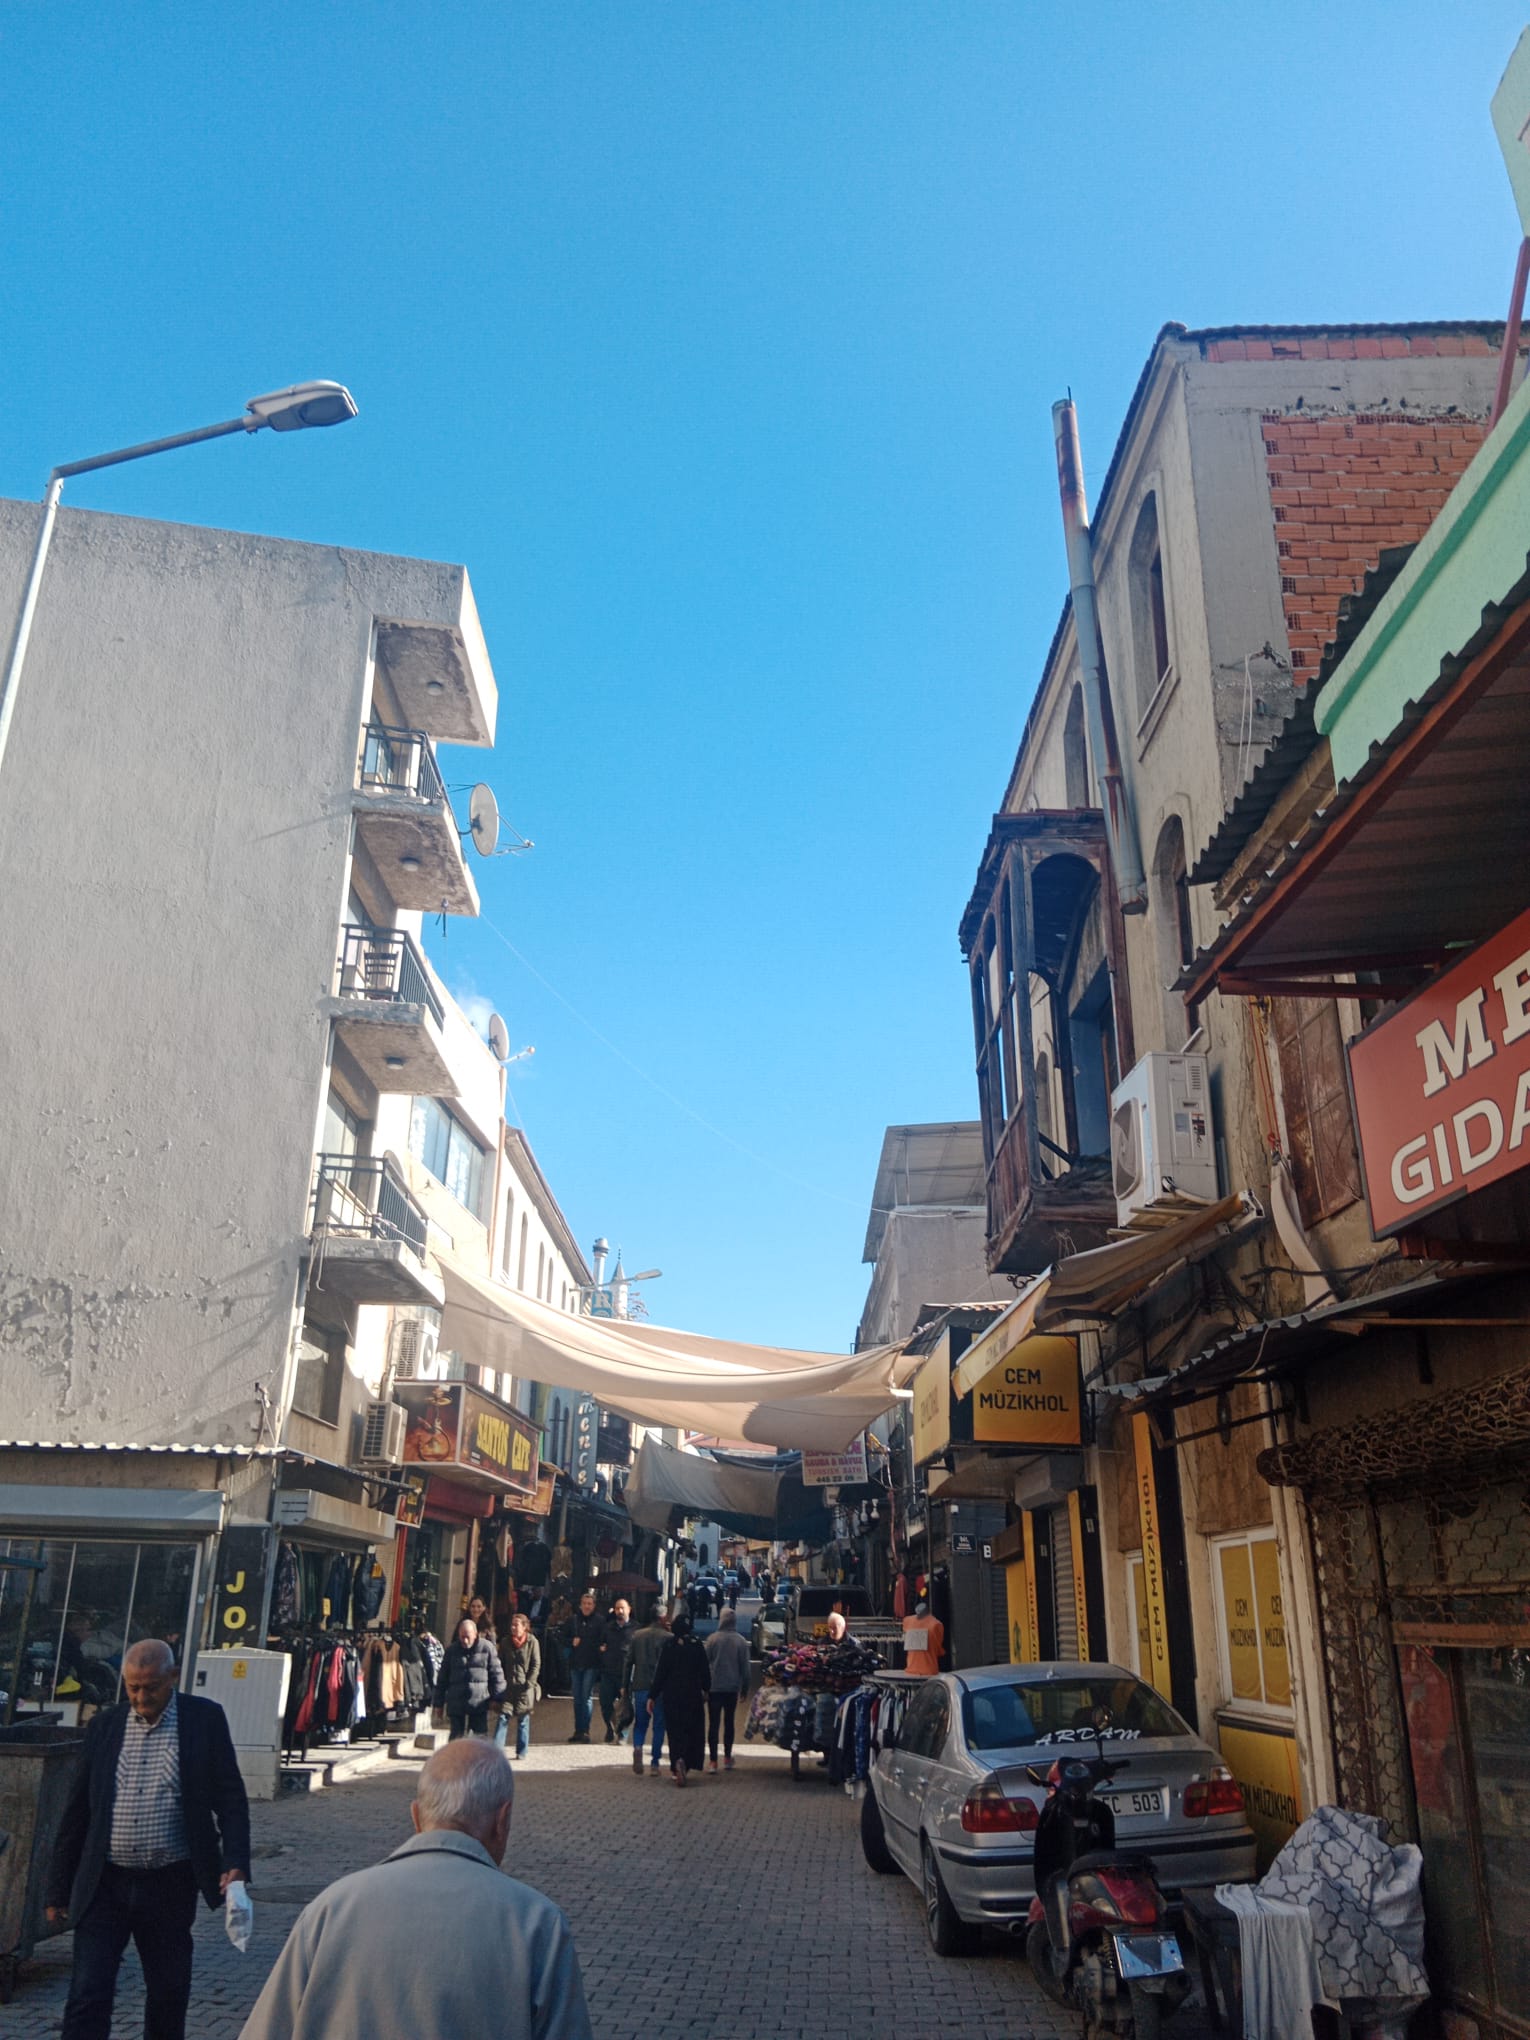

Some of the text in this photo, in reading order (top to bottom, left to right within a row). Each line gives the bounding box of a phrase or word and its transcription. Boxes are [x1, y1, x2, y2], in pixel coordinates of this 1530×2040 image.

[1005, 1368, 1041, 1385] CEM
[980, 1389, 1069, 1412] MÜZİKHOL
[476, 1412, 532, 1472] SANTOS CAFE
[1142, 1467, 1159, 1598] MÜZİKHOL
[983, 1544, 992, 1558] B
[1235, 1598, 1249, 1617] CEM
[1152, 1606, 1164, 1661] CEM
[1035, 1726, 1142, 1745] ARDAM
[1132, 1793, 1161, 1813] 503
